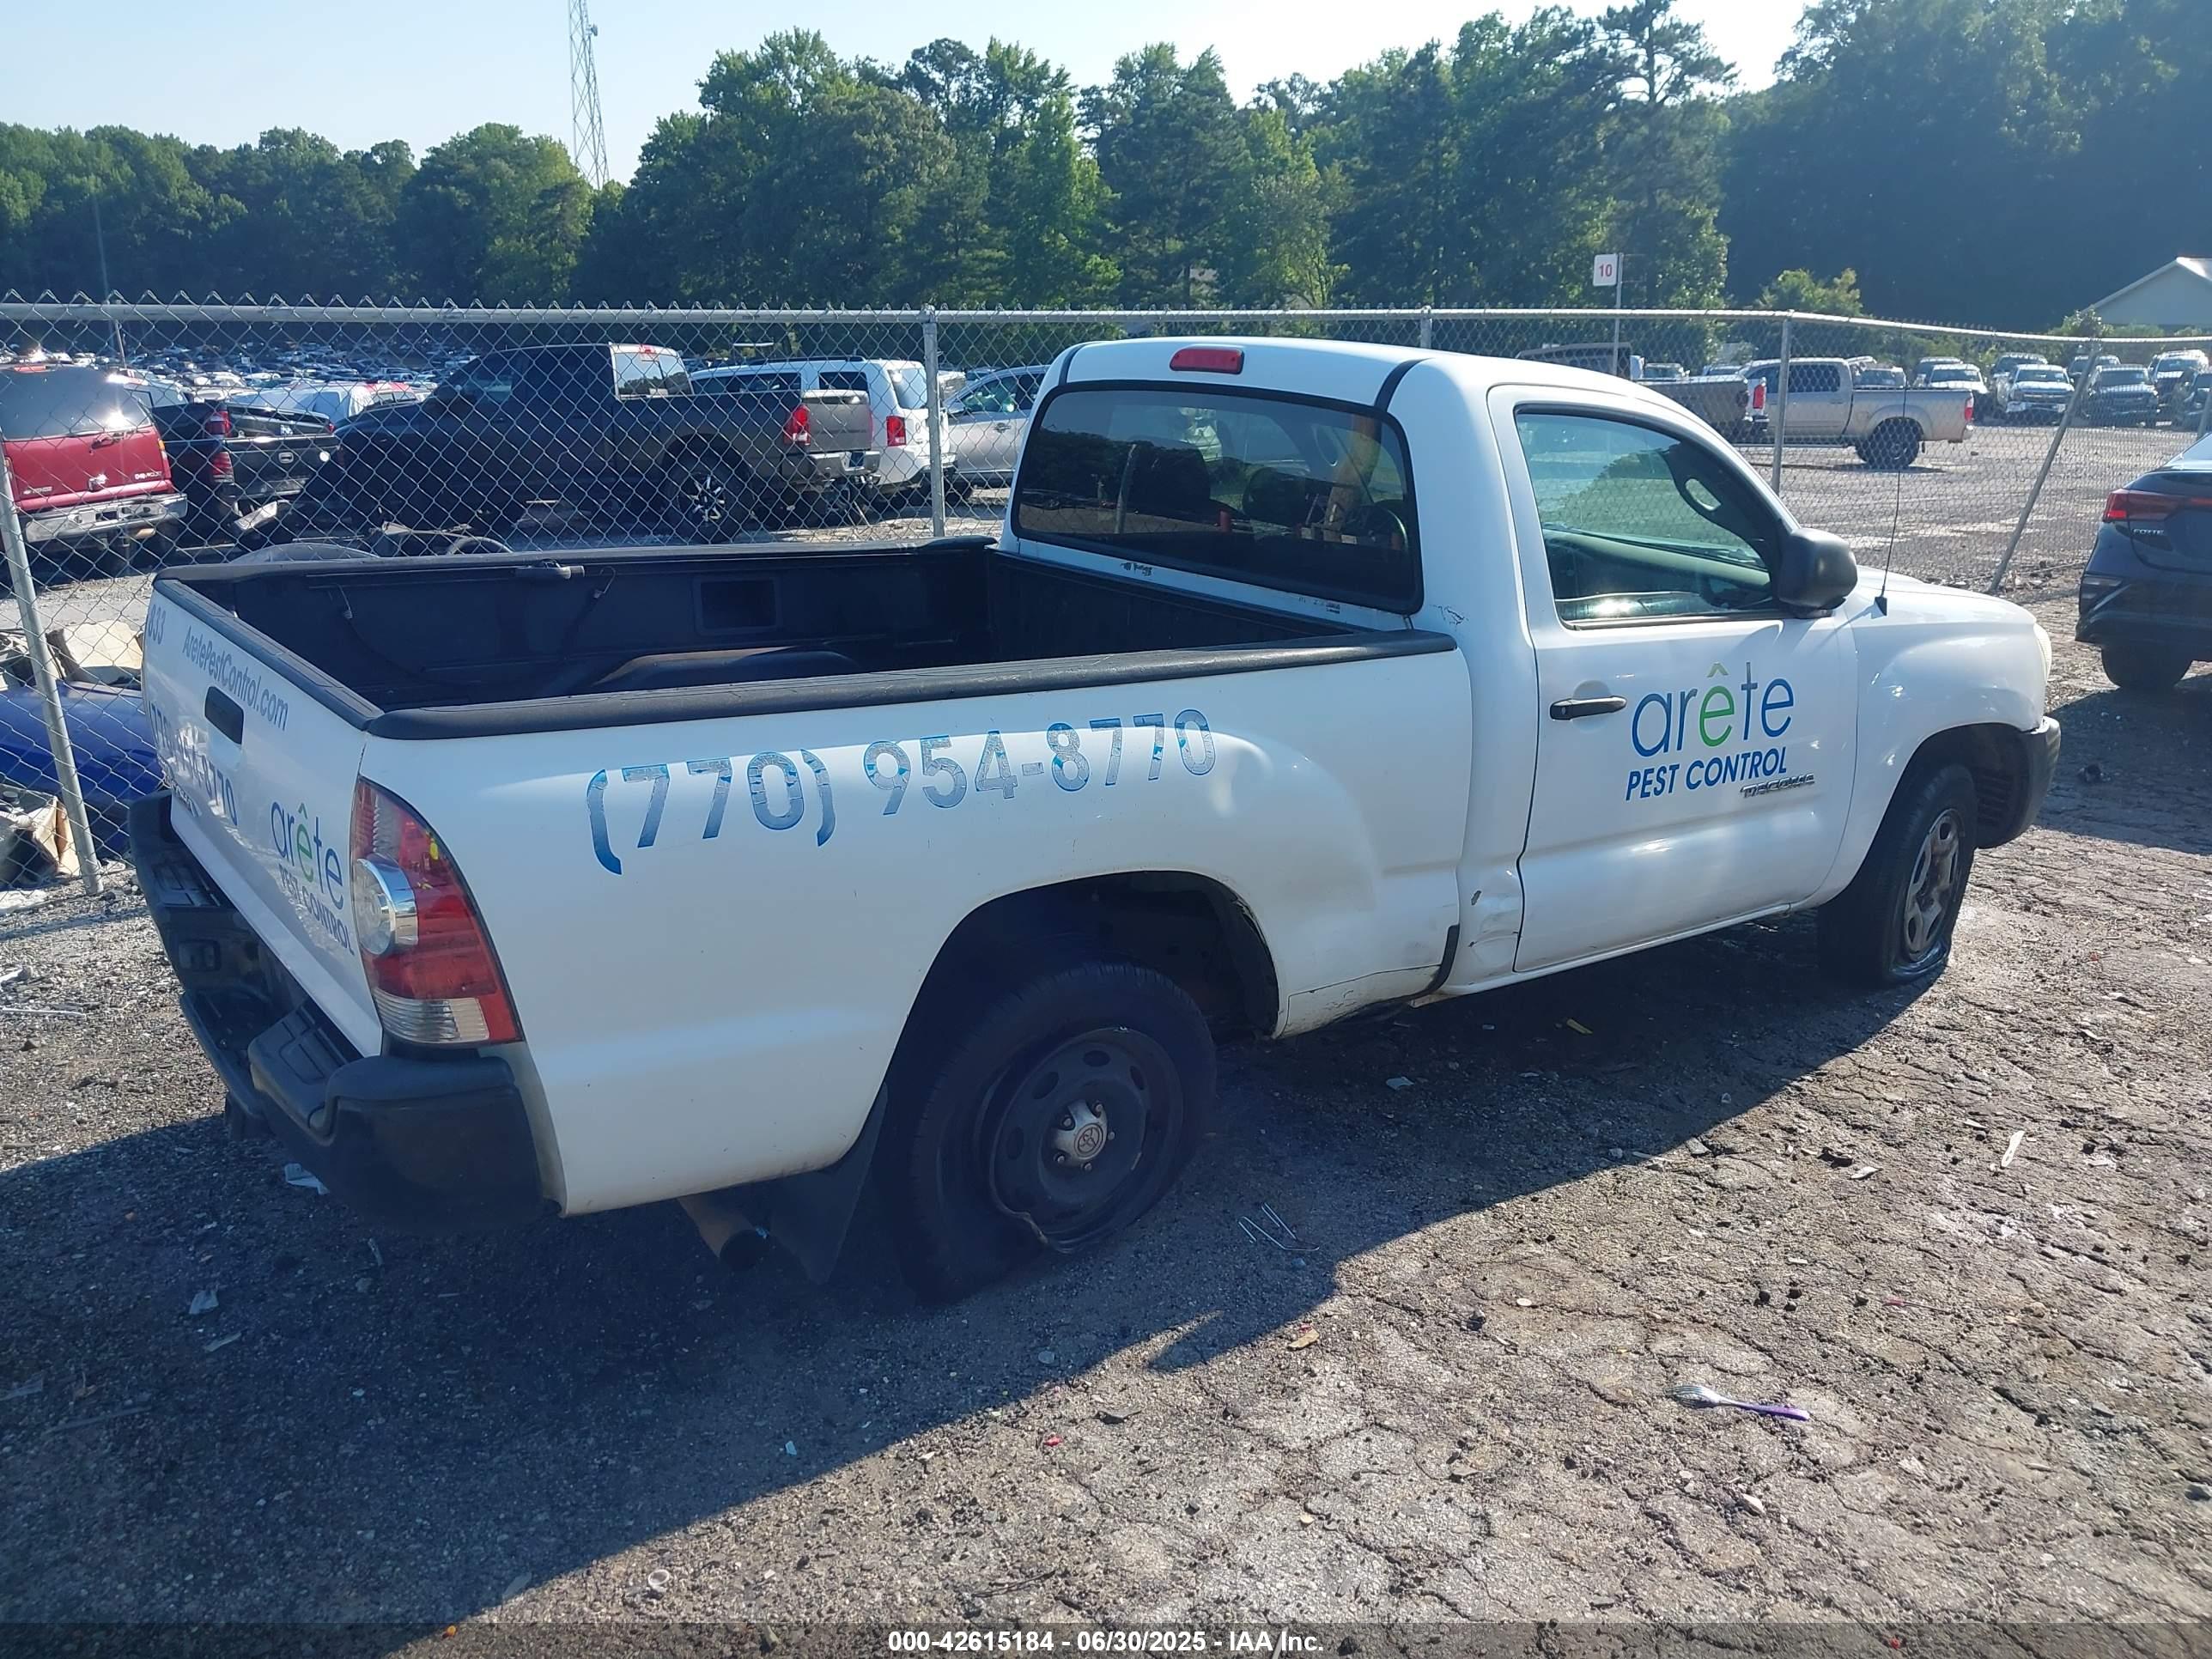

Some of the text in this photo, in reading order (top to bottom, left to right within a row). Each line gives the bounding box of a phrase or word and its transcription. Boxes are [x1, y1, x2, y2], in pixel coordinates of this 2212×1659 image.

[1598, 263, 1613, 277] 10
[182, 624, 289, 731] AretePestControl.com
[1632, 661, 1794, 757] arête
[586, 708, 1217, 875] (770) 954-8770
[1626, 746, 1787, 801] PEST CONTROL
[278, 863, 355, 957] PEST CONTROL
